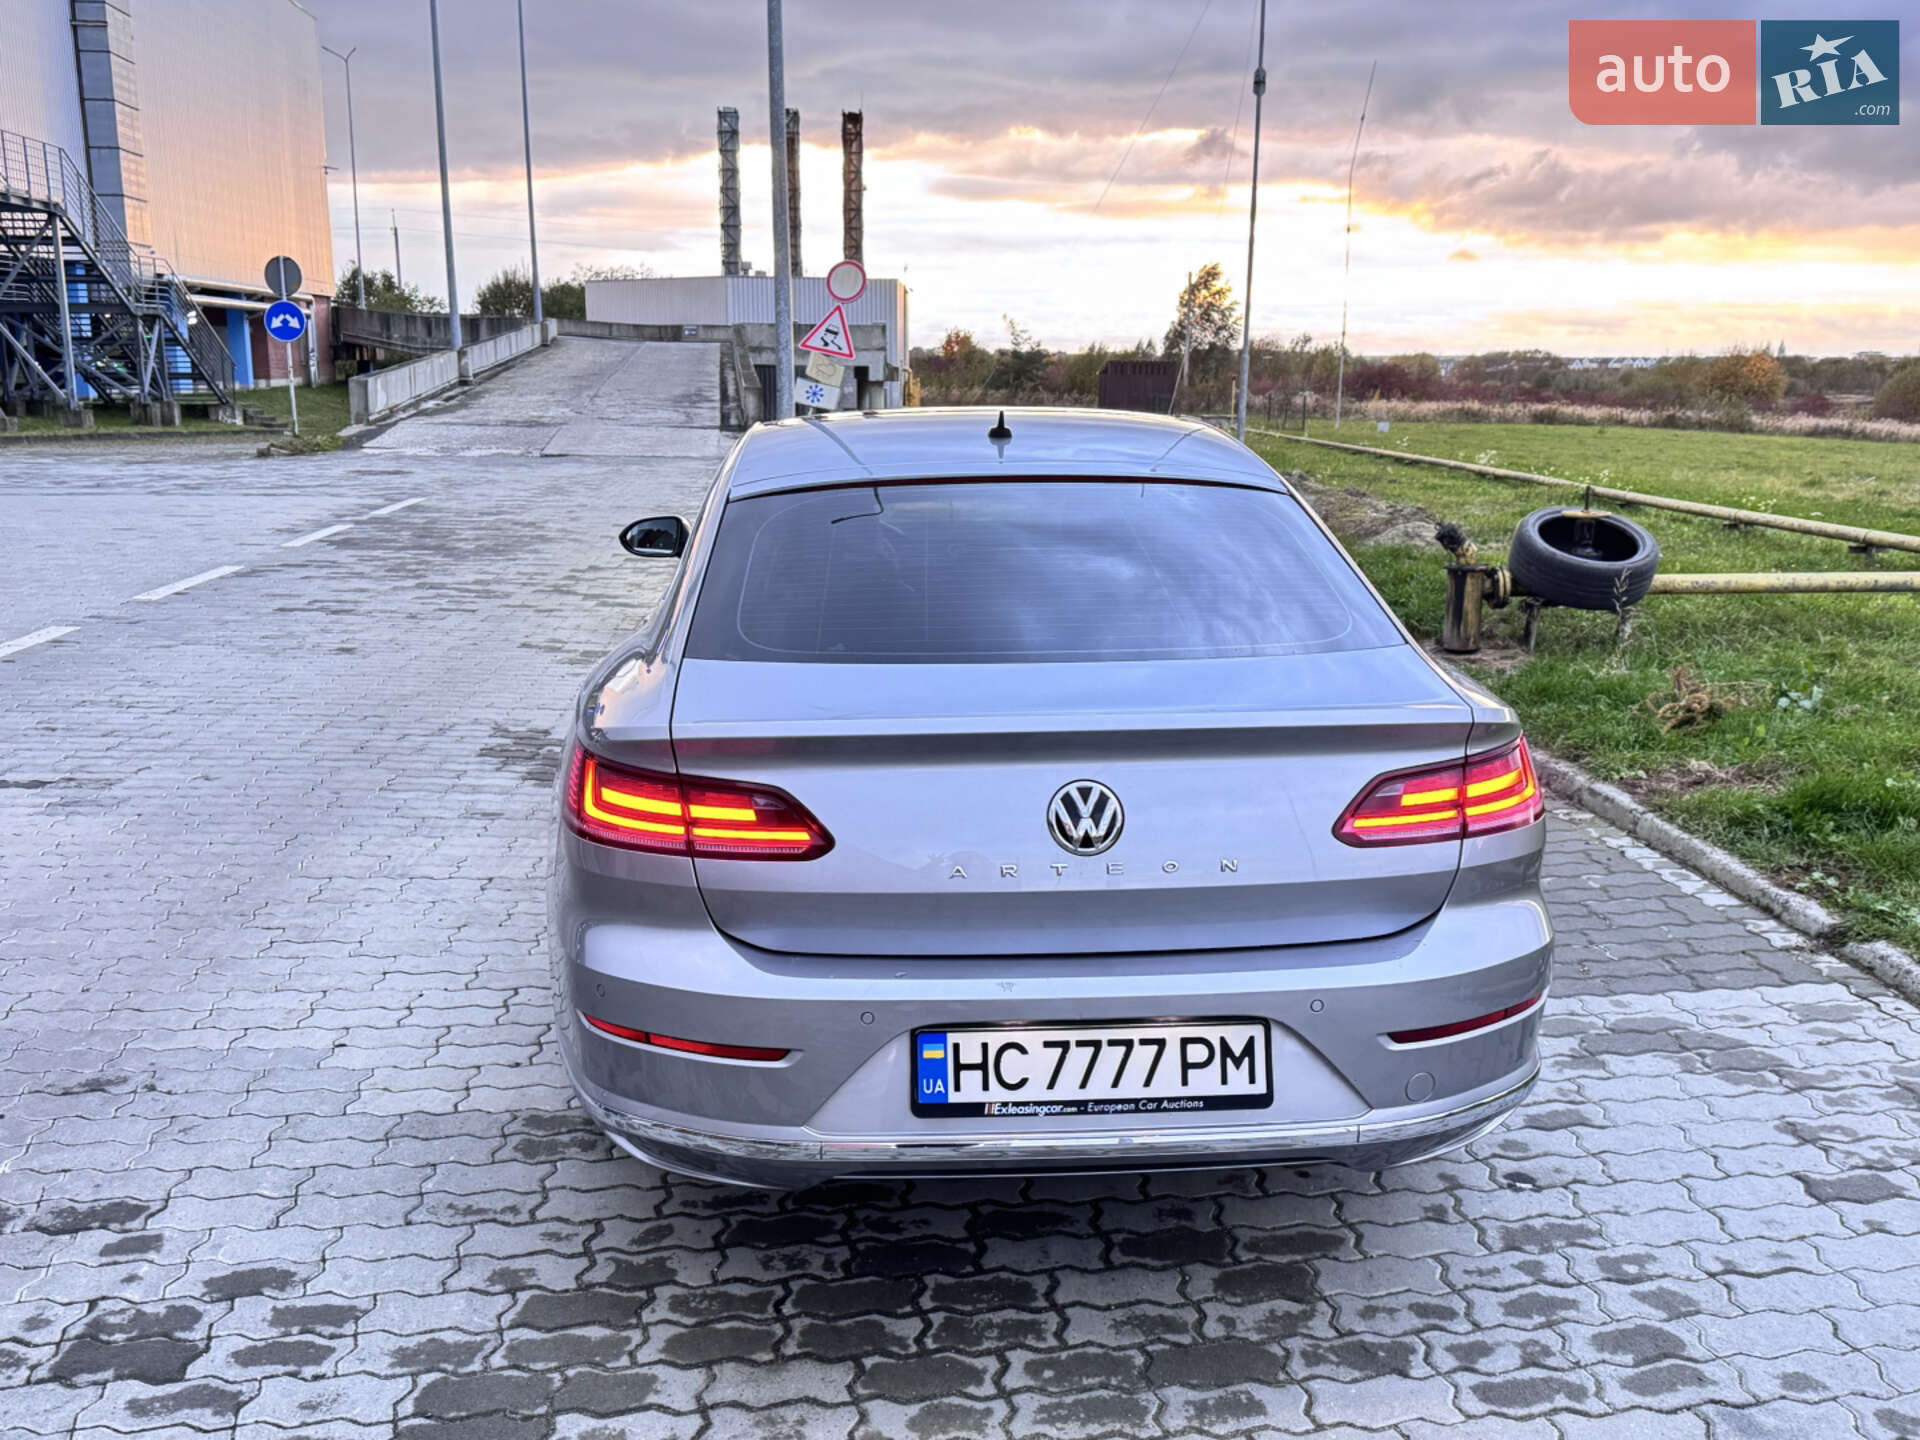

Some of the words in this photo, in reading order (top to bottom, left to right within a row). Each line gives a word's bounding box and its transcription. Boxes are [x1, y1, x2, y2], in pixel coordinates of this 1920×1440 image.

[949, 858, 1239, 880] ARTEON
[951, 1041, 1030, 1093] HC
[1042, 1038, 1167, 1091] 7777
[1179, 1034, 1257, 1087] PM
[923, 1078, 946, 1094] UA
[1087, 1102, 1135, 1114] European
[1139, 1099, 1158, 1110] Car
[1160, 1099, 1204, 1109] Auctions
